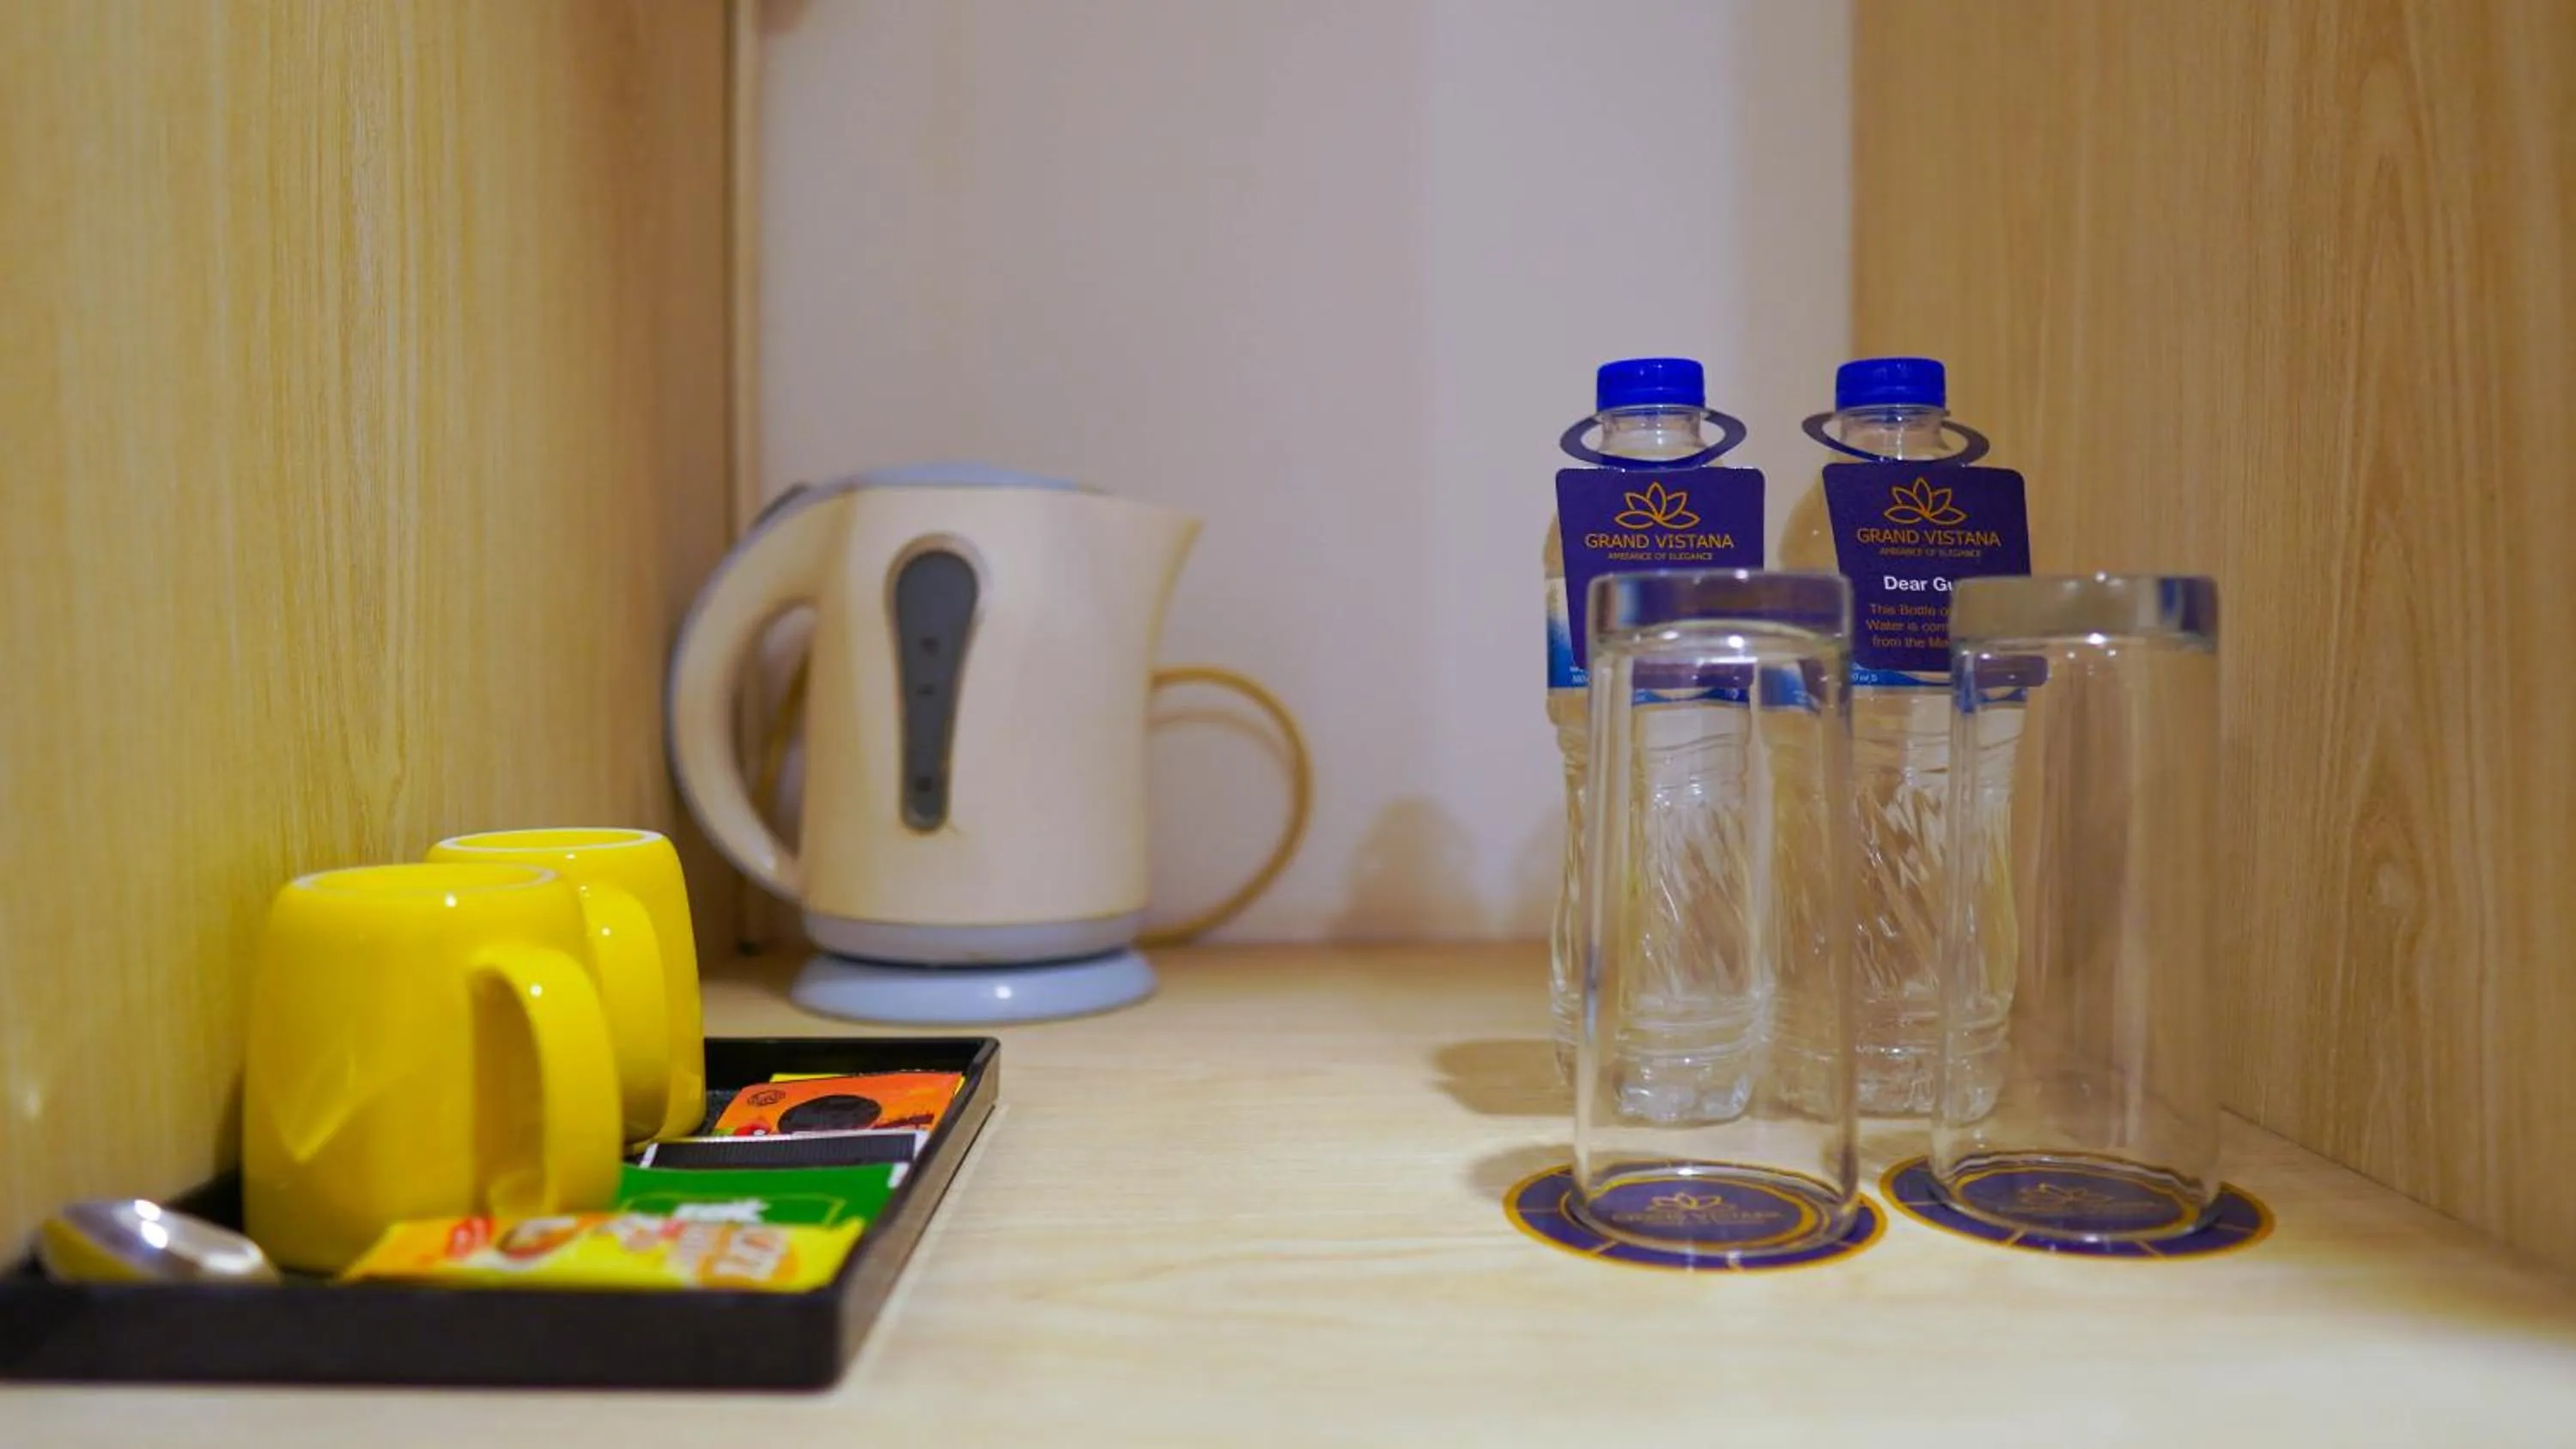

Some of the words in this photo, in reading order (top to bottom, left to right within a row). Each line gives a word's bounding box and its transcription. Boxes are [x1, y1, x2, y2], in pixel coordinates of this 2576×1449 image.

[1584, 533, 1649, 549] GRAND
[1655, 533, 1735, 549] VISTANA
[1856, 527, 1920, 544] GRAND
[1923, 530, 2002, 547] VISTANA
[1654, 552, 1668, 561] OF
[1883, 575, 1929, 591] Dear
[1869, 603, 1896, 615] This
[1865, 620, 1905, 631] Water
[1905, 636, 1924, 648] the
